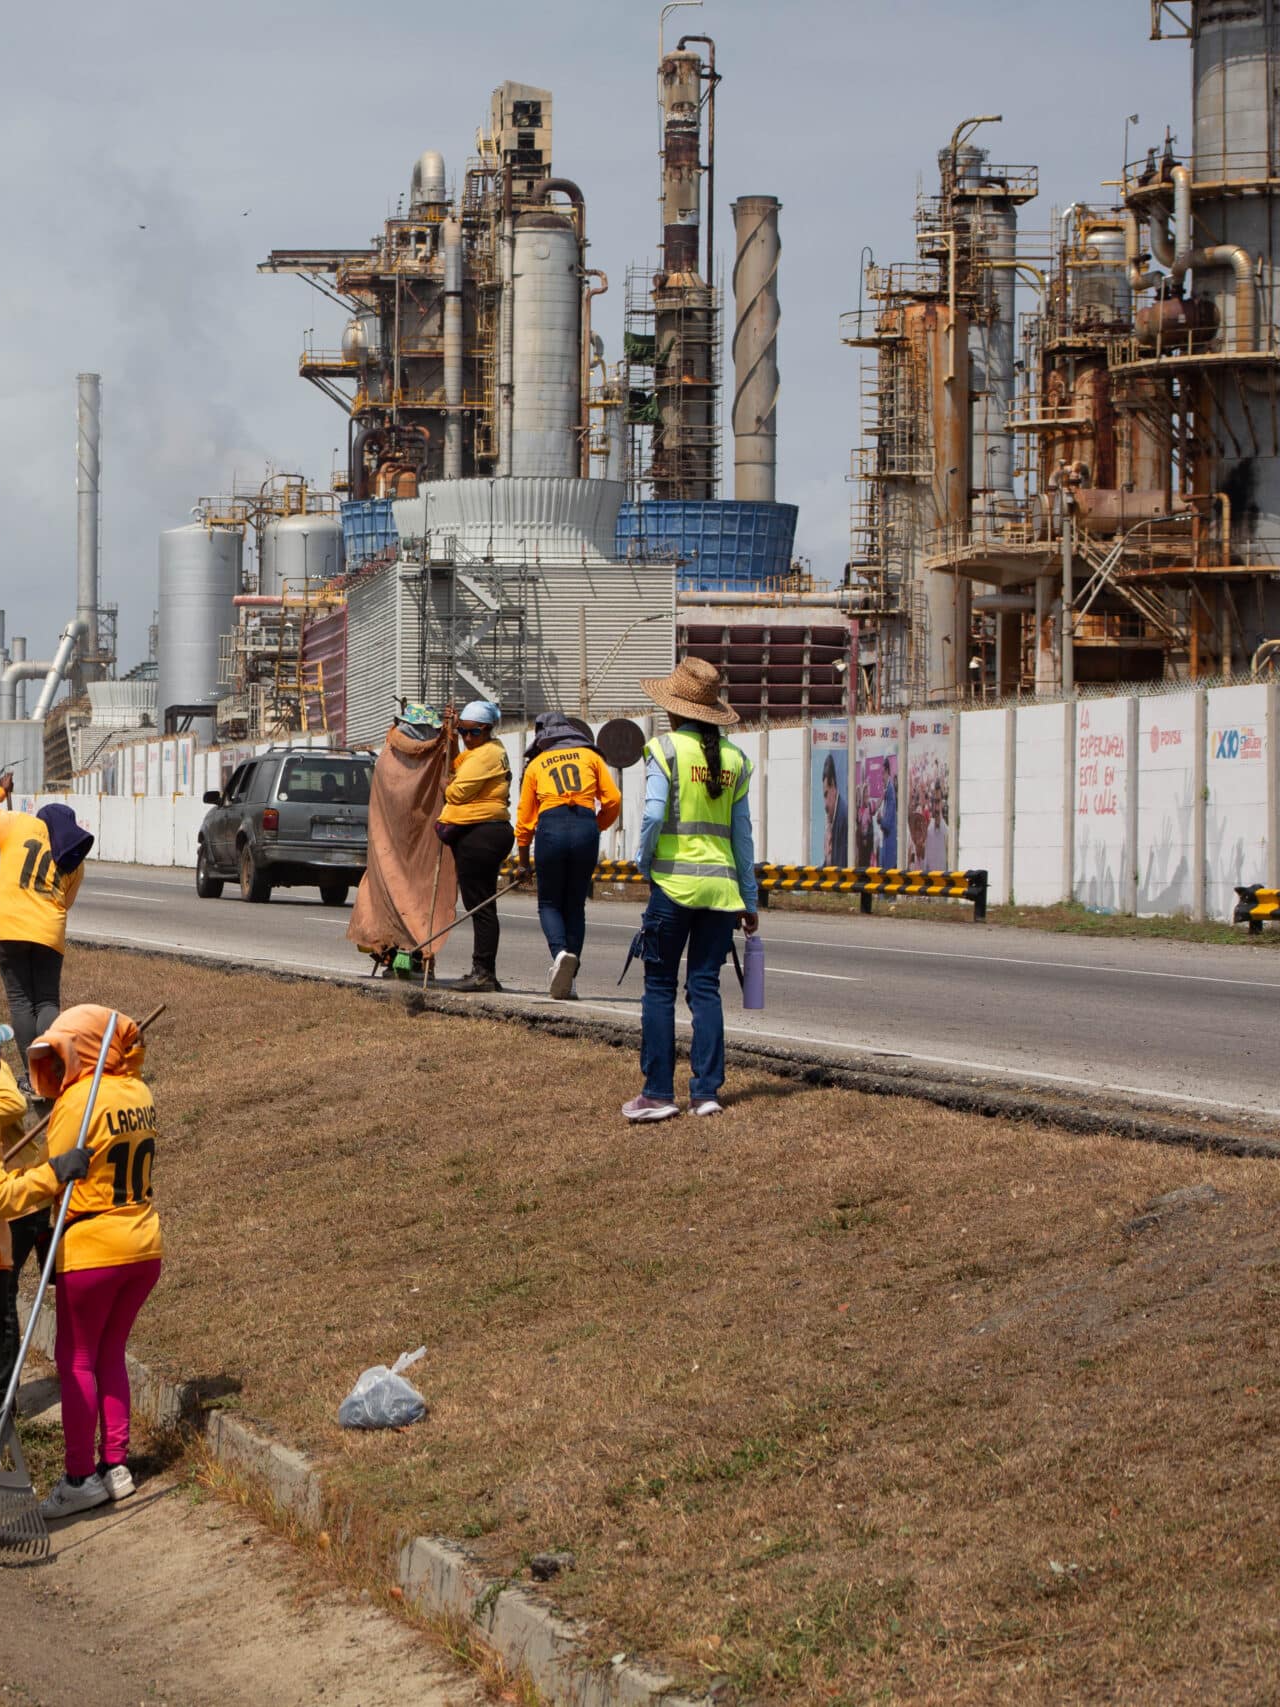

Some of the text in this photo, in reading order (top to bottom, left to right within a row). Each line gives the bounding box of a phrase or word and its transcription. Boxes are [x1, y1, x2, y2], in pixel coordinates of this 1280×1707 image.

[1160, 730, 1182, 745] PDVSA
[549, 763, 581, 795] 10
[106, 1137, 155, 1207] 10
